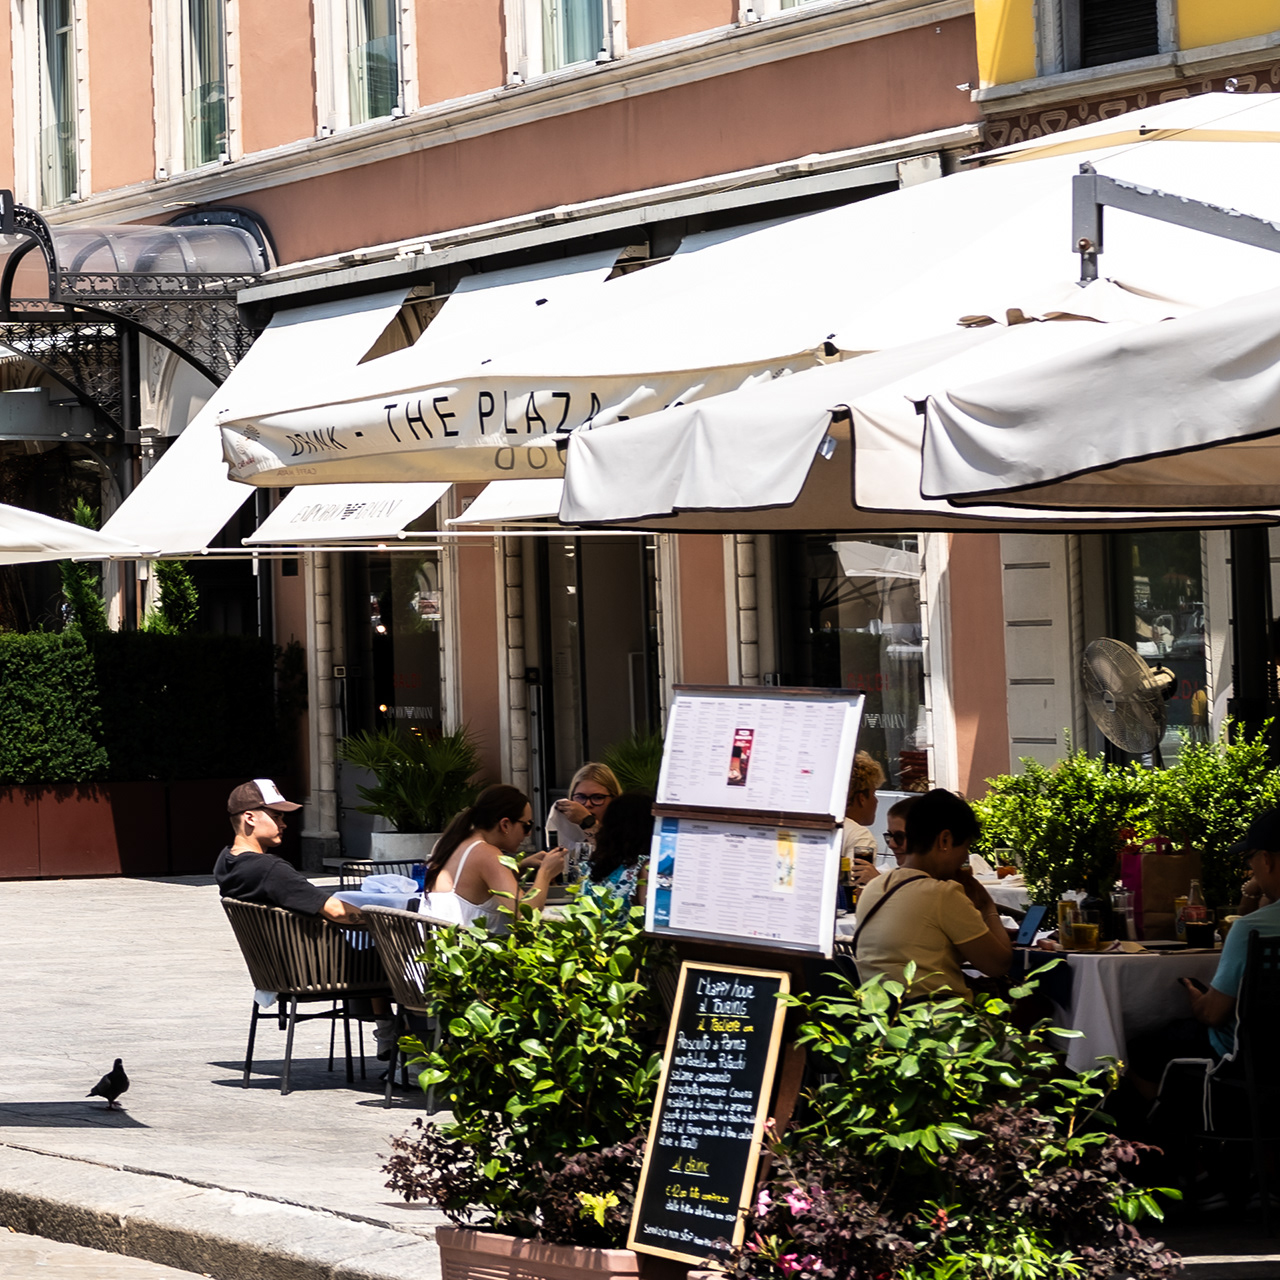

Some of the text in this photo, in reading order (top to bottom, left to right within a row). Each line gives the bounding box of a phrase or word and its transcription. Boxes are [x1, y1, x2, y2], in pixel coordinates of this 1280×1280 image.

[286, 390, 602, 457] DRINK THE PLAZA
